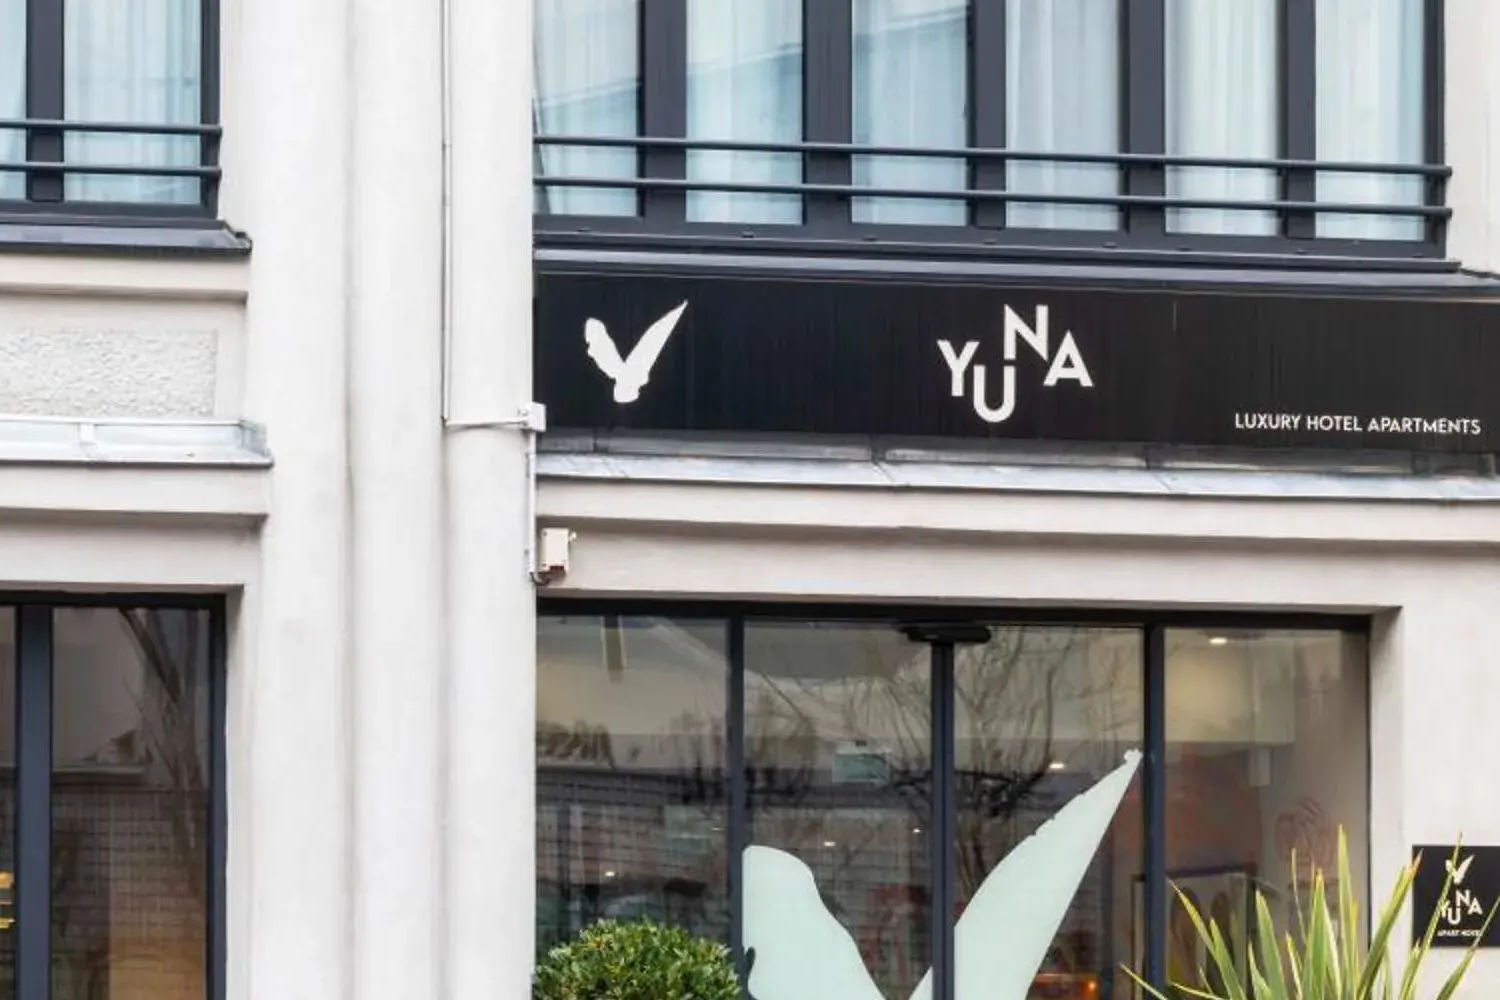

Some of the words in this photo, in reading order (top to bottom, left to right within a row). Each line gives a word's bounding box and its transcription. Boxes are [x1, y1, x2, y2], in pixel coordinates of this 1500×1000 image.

[936, 303, 1095, 423] YUNA
[1234, 412, 1301, 431] LUXURY
[1306, 414, 1363, 433] HOTEL
[1367, 416, 1482, 436] APARTMENTS
